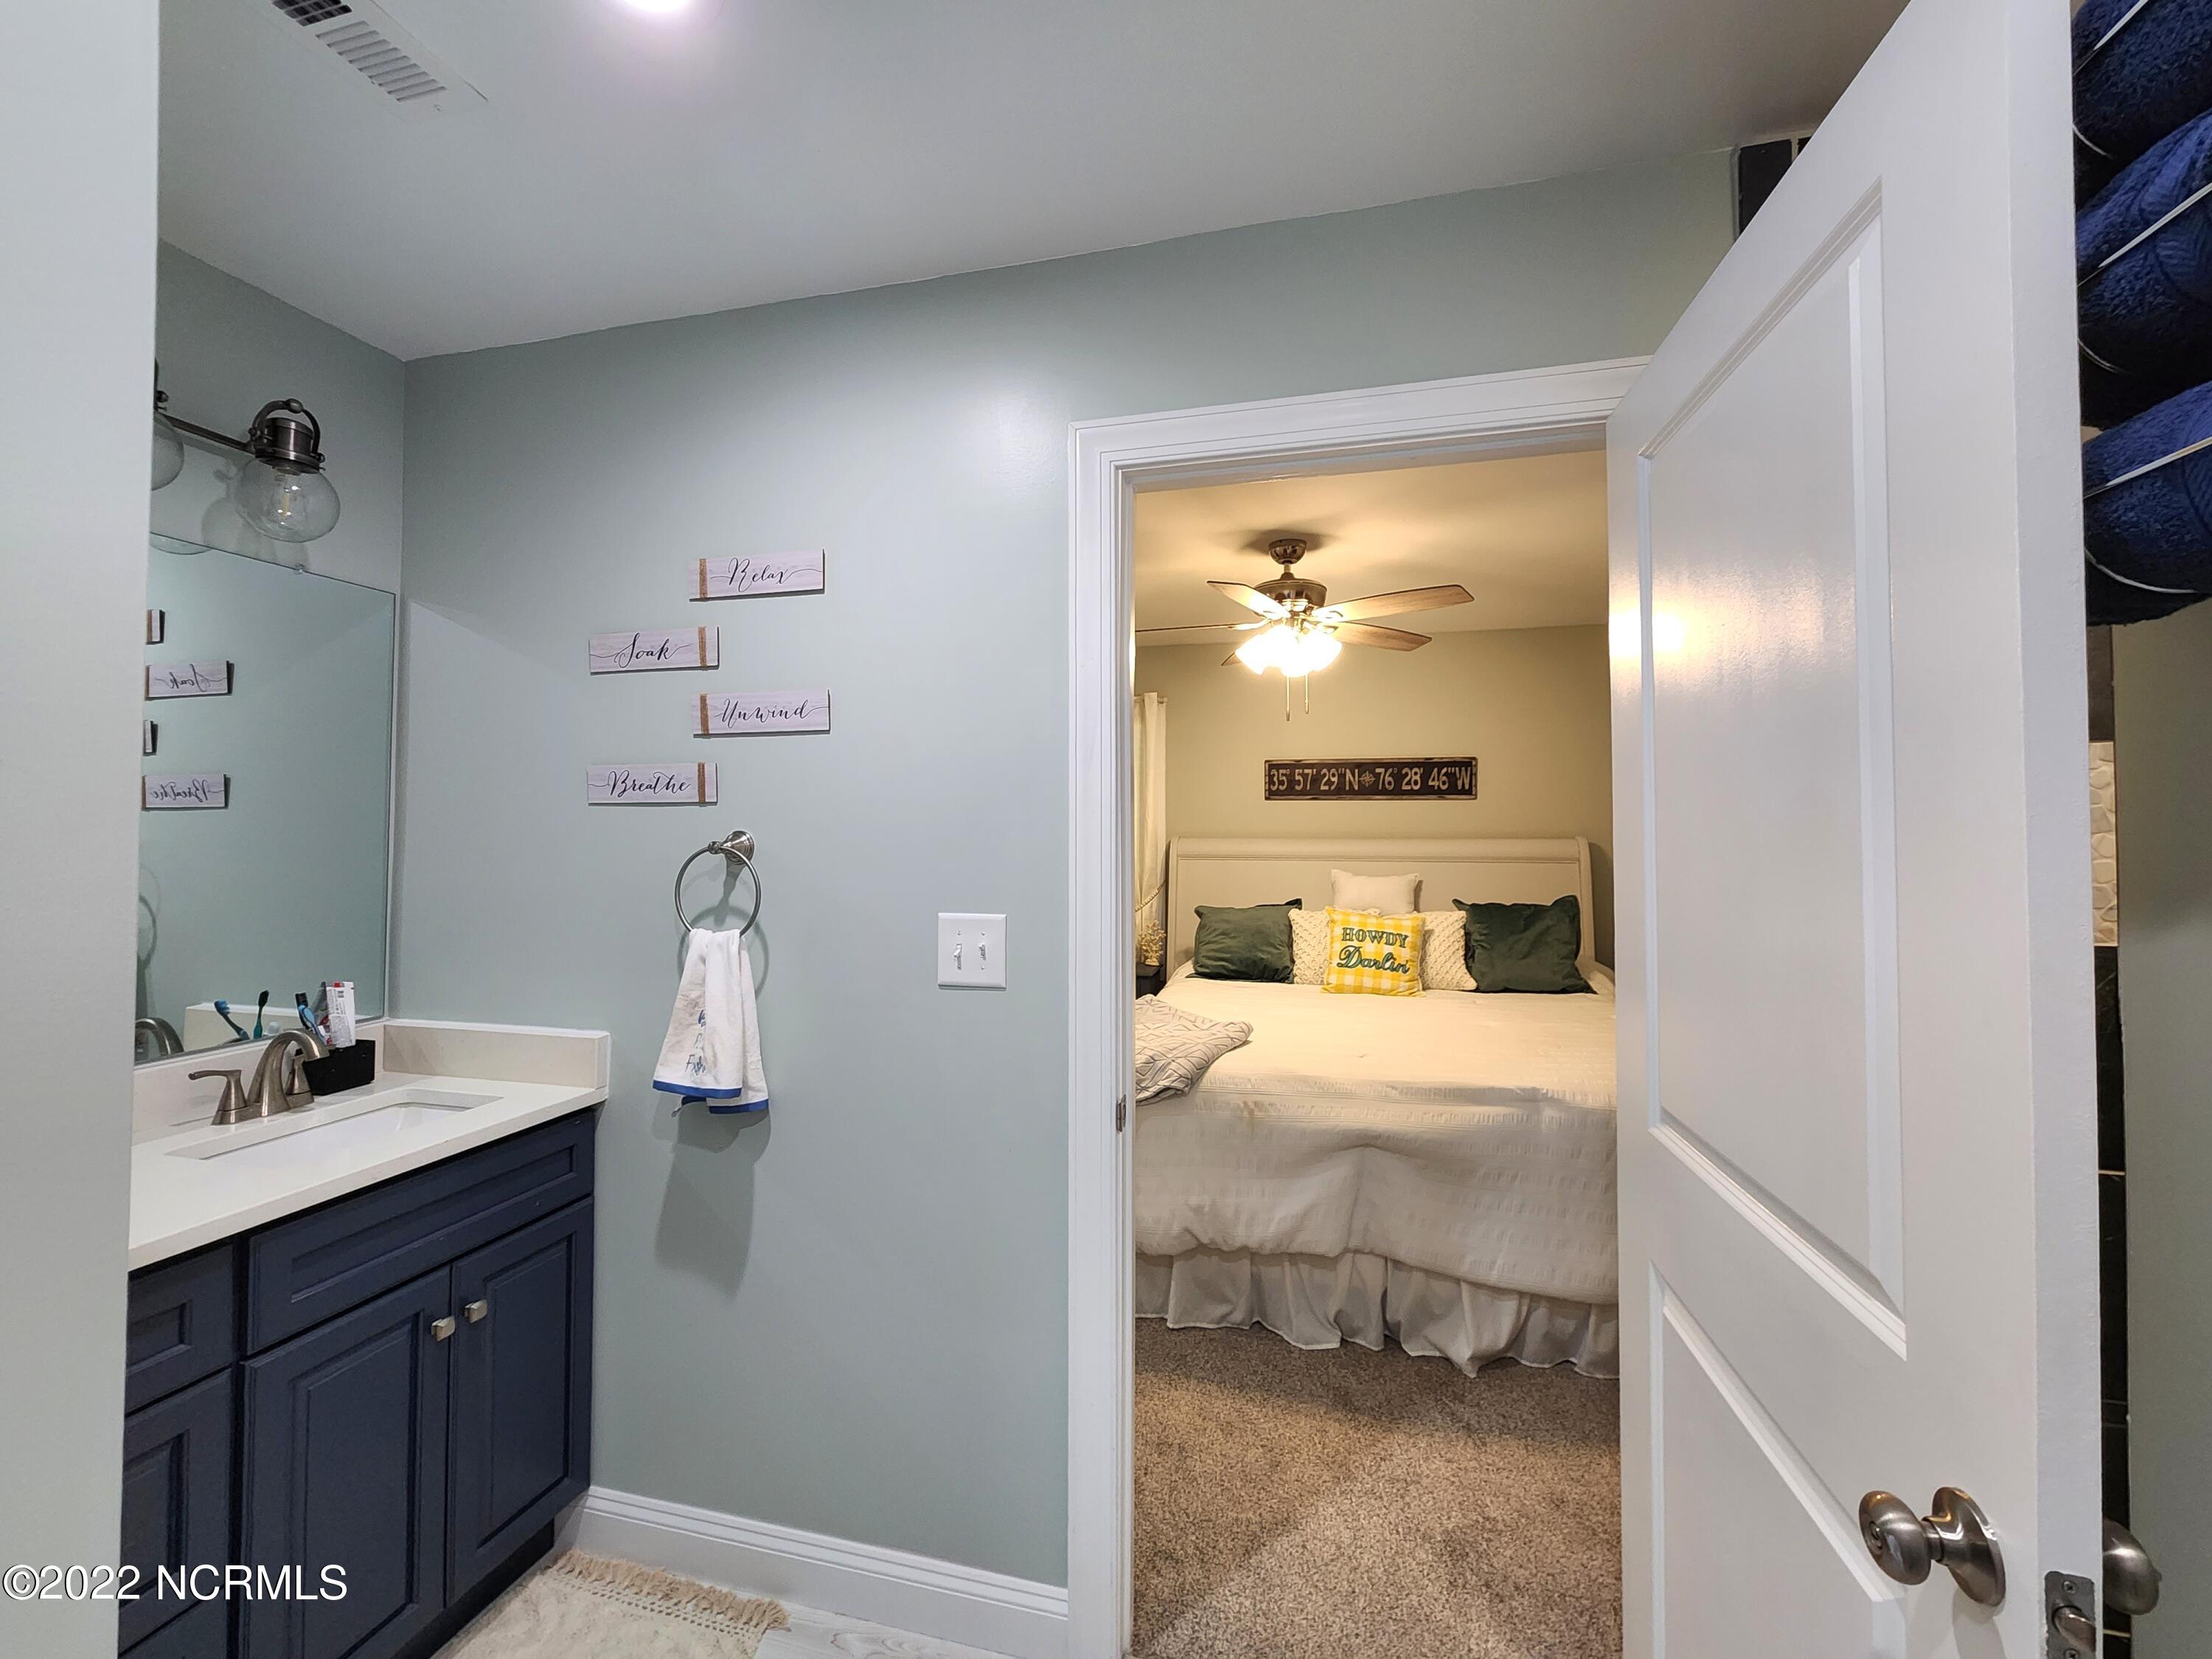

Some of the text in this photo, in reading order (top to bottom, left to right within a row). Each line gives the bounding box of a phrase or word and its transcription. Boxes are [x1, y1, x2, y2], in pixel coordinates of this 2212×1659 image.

[718, 557, 807, 592] Relax
[600, 633, 683, 668] Soak
[715, 698, 820, 728] Unwind
[600, 769, 691, 798] Breathe
[1341, 927, 1409, 948] HOWDY
